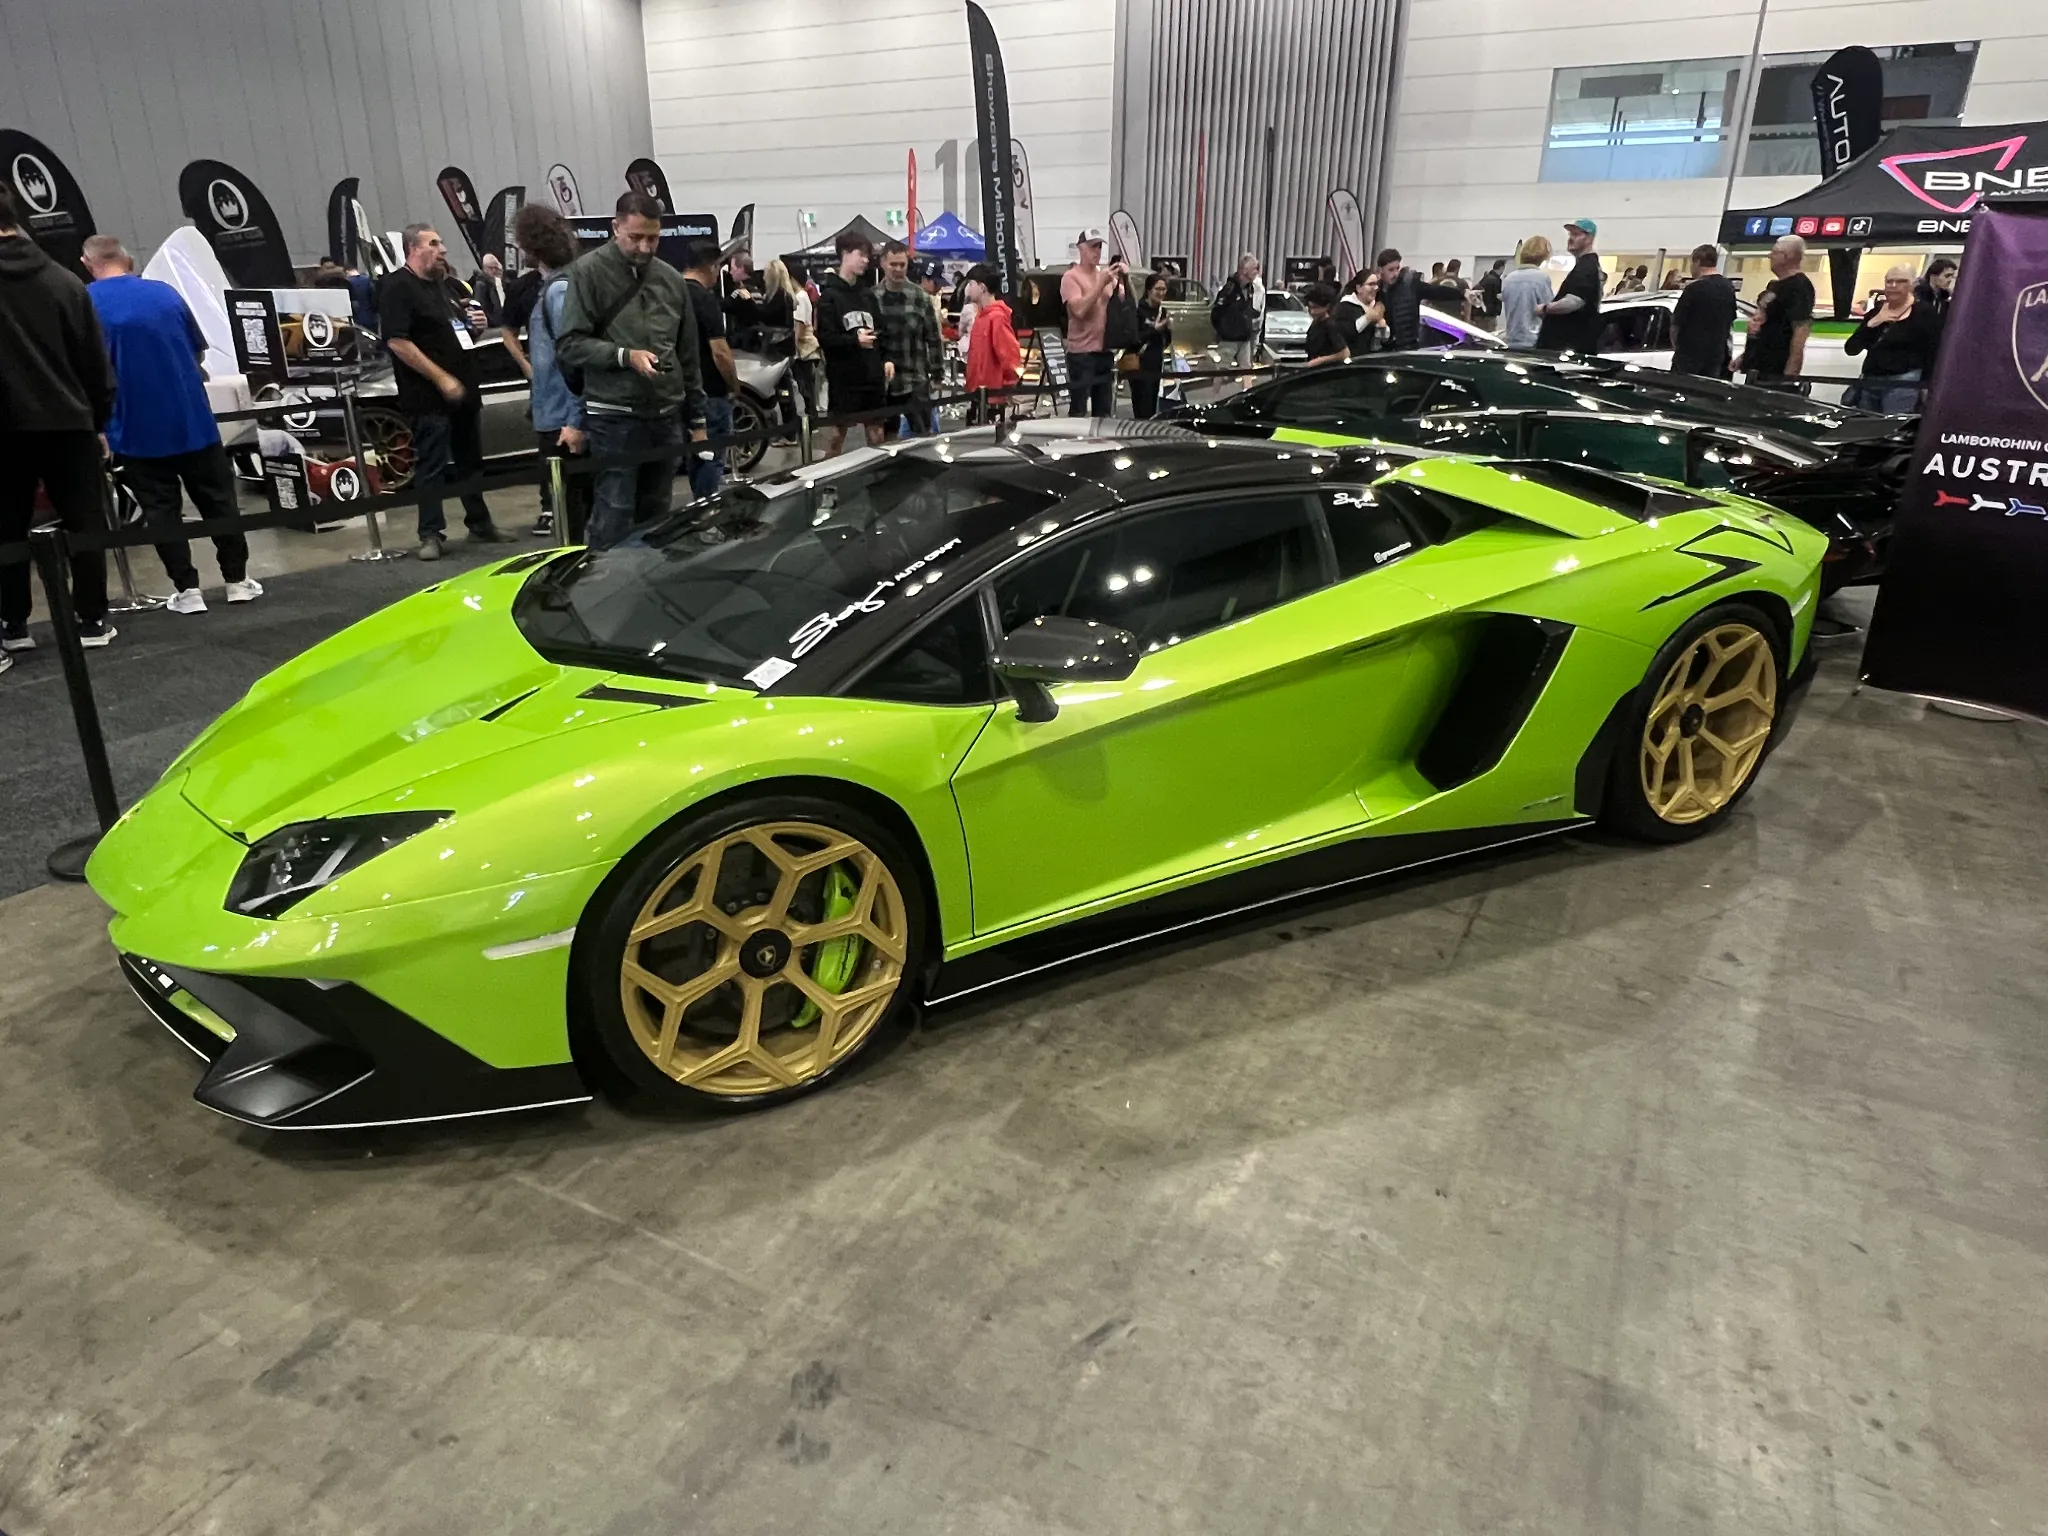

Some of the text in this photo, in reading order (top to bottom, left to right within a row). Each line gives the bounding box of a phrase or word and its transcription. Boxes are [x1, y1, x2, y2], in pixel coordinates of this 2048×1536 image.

[985, 53, 1009, 294] Showcars Melbourne
[1940, 433, 2042, 451] LAMBORGHINI
[1922, 453, 2048, 487] AUSTR
